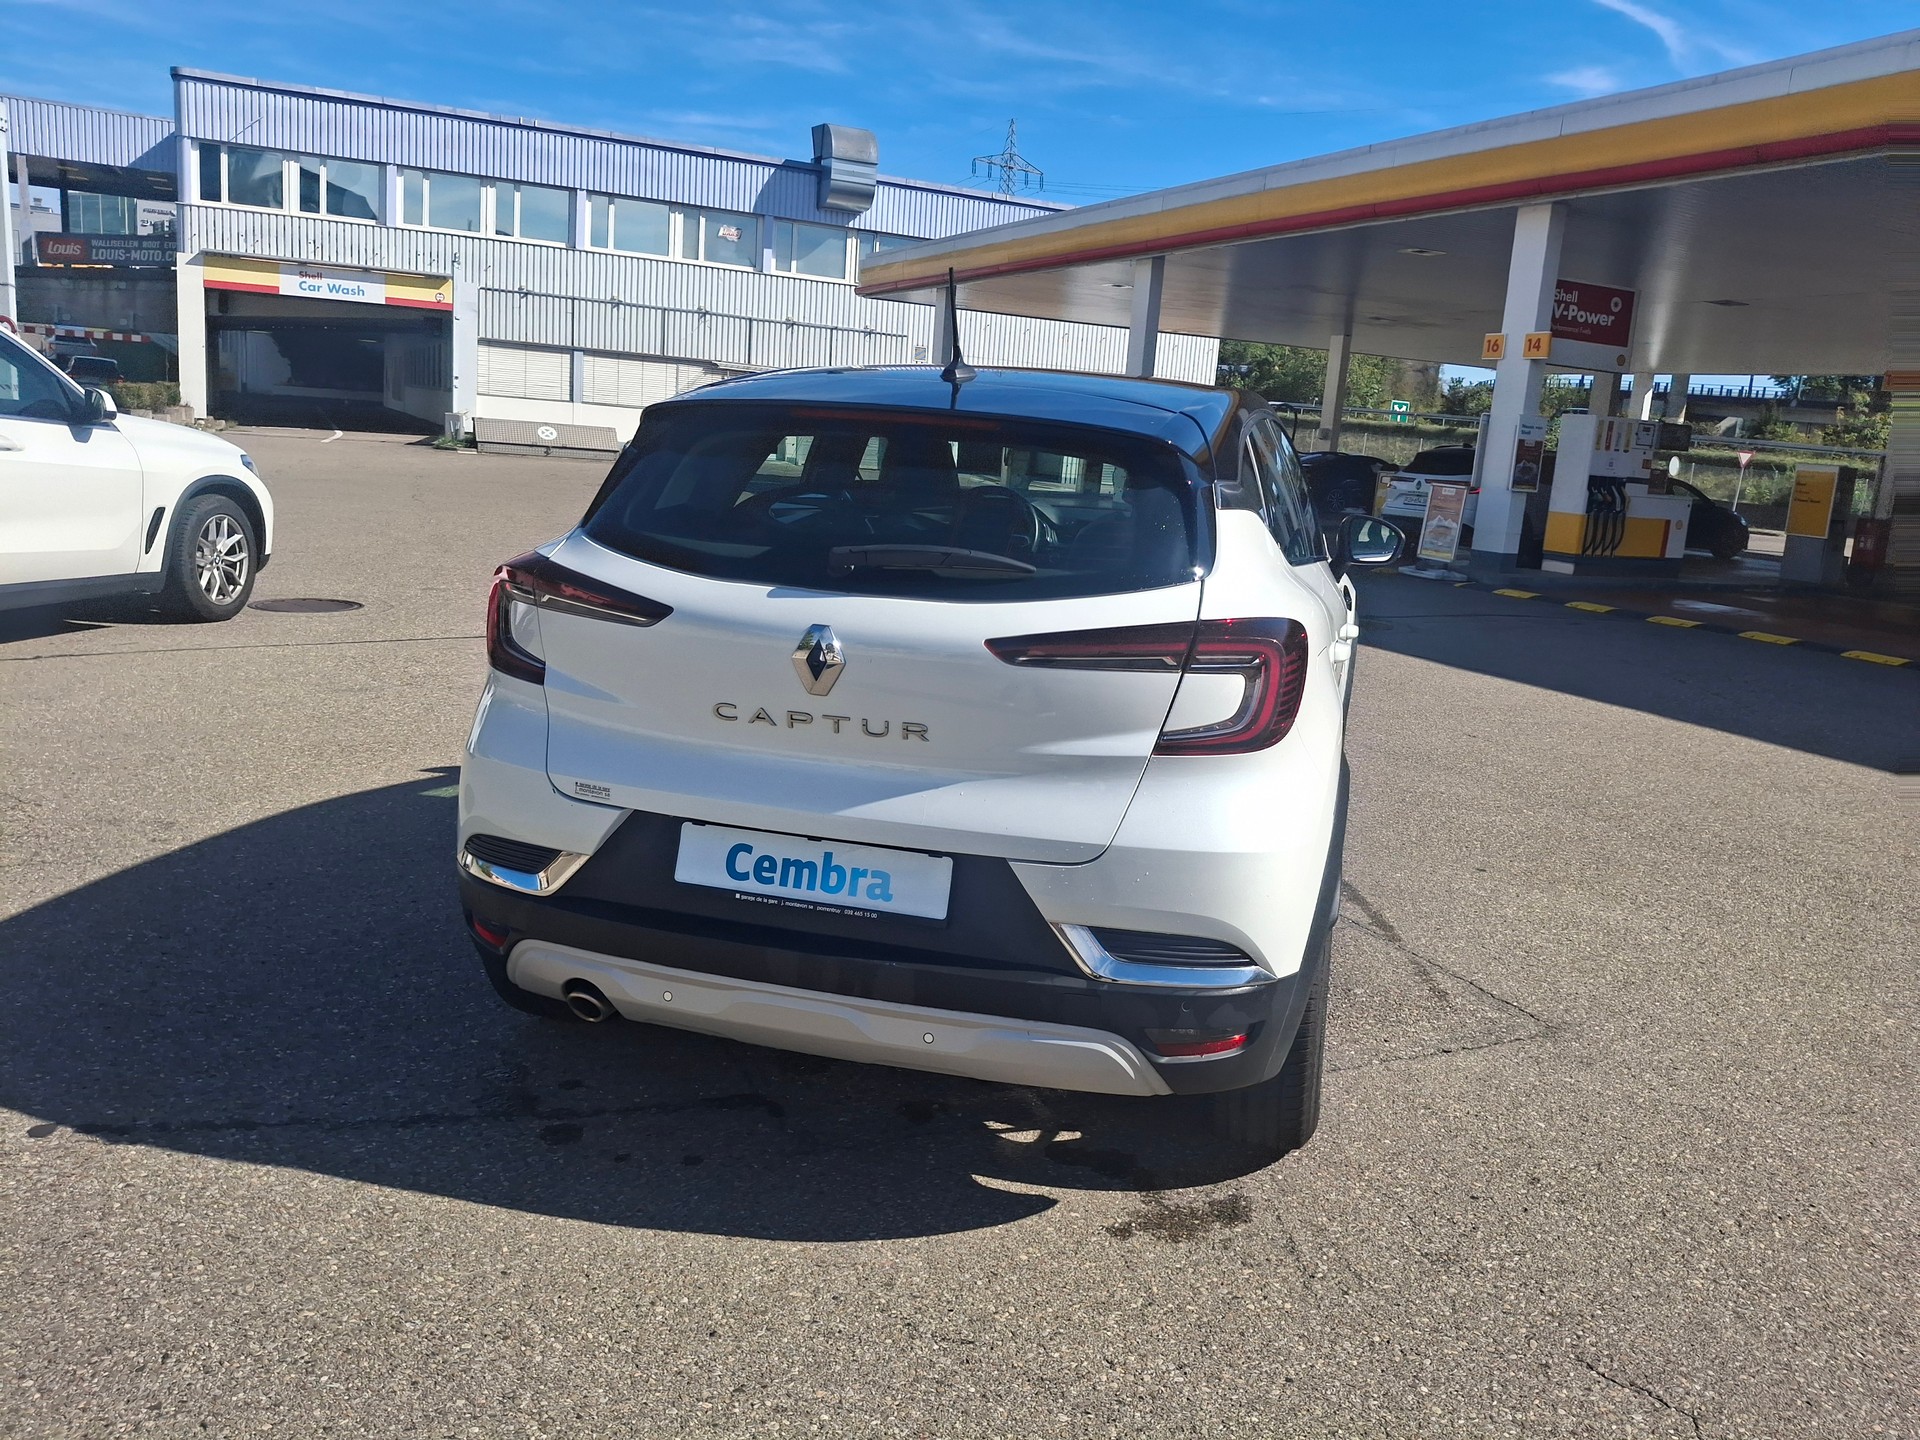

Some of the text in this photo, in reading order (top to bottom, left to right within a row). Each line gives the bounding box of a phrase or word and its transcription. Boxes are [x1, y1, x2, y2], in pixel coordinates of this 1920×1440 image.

[47, 241, 82, 255] Louis
[91, 239, 138, 248] WALLISELLEN
[298, 271, 323, 281] Shell
[298, 281, 365, 297] Car Wash
[1554, 288, 1579, 302] Shell
[1553, 303, 1615, 326] V-Power
[1486, 338, 1500, 353] 16
[1527, 337, 1542, 352] 14
[712, 702, 930, 742] CAPTUR
[725, 842, 894, 903] Cembra
